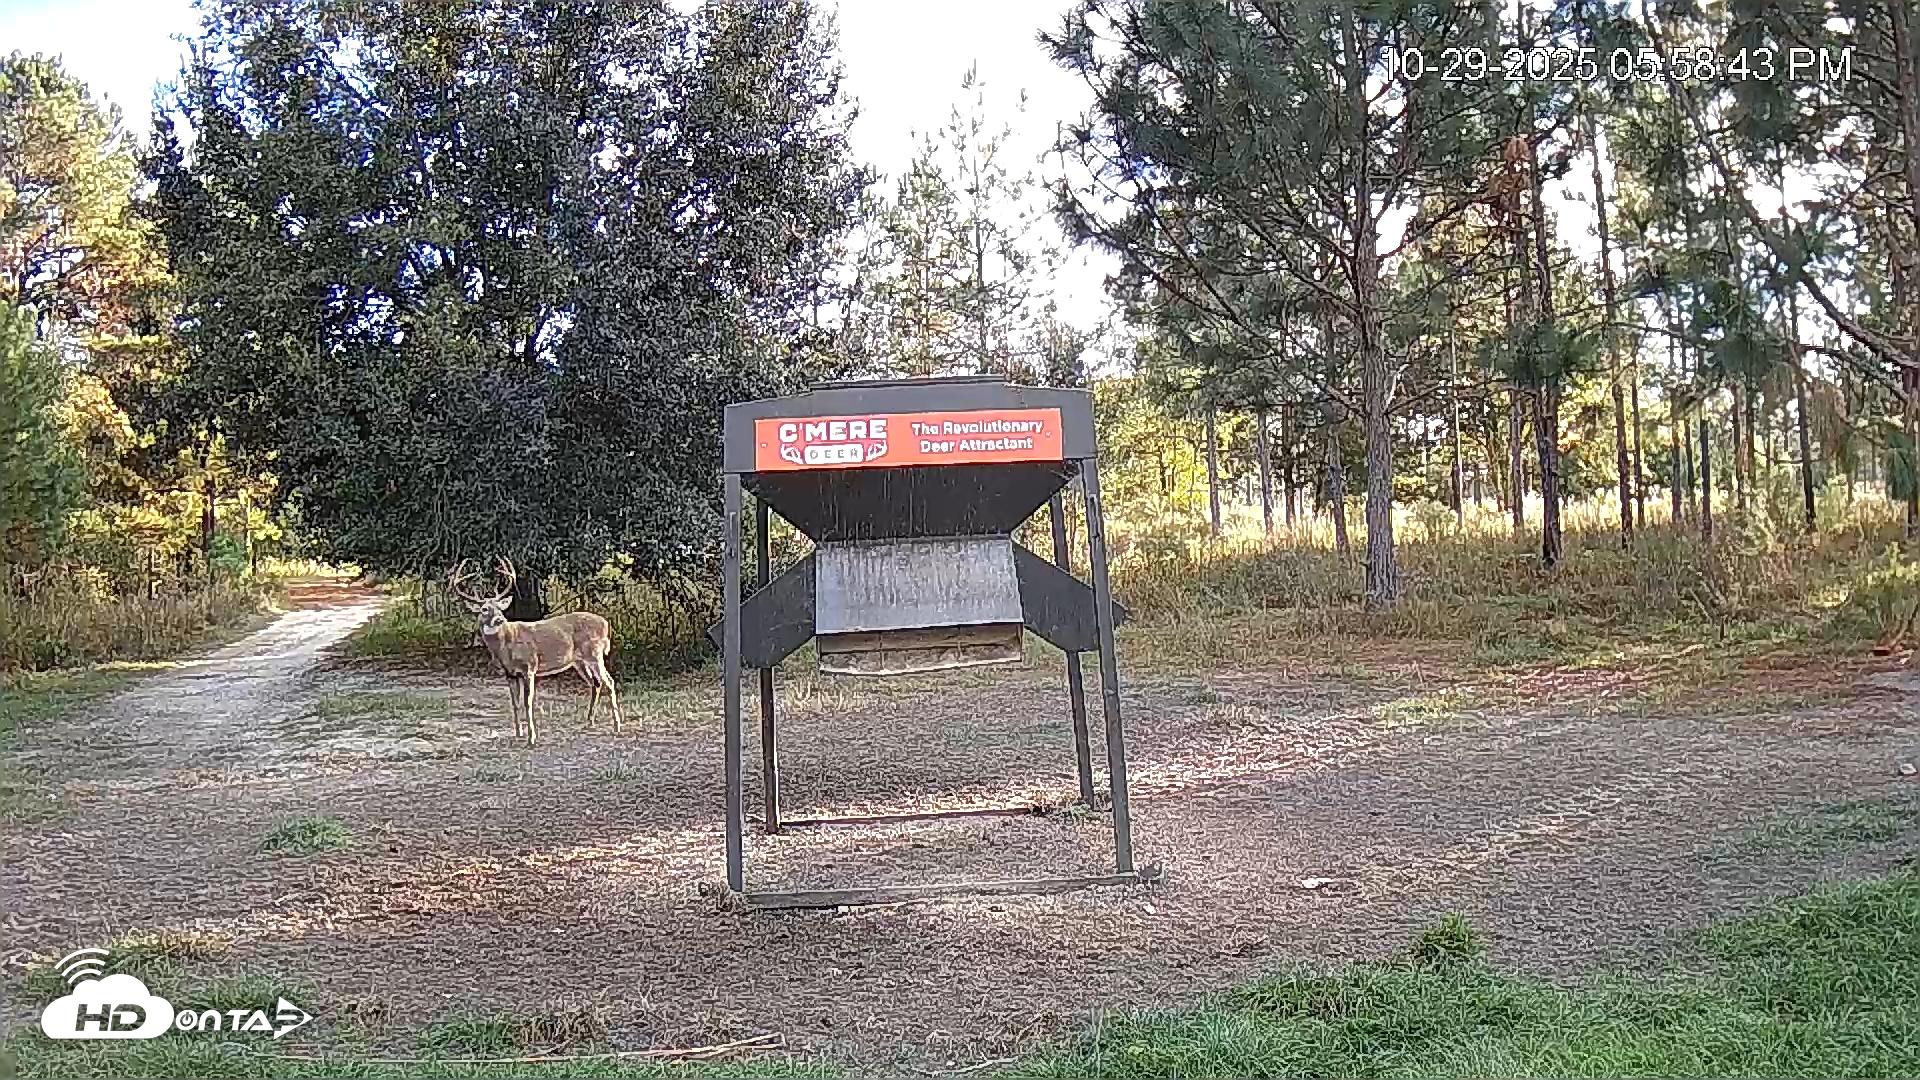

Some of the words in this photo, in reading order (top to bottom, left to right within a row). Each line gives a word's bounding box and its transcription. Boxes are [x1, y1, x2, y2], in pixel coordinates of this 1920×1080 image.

[911, 422, 938, 435] The
[943, 420, 1043, 435] Revolutionary
[920, 440, 955, 453] Deer
[959, 437, 1033, 451] Attractant
[809, 449, 859, 460] DEER
